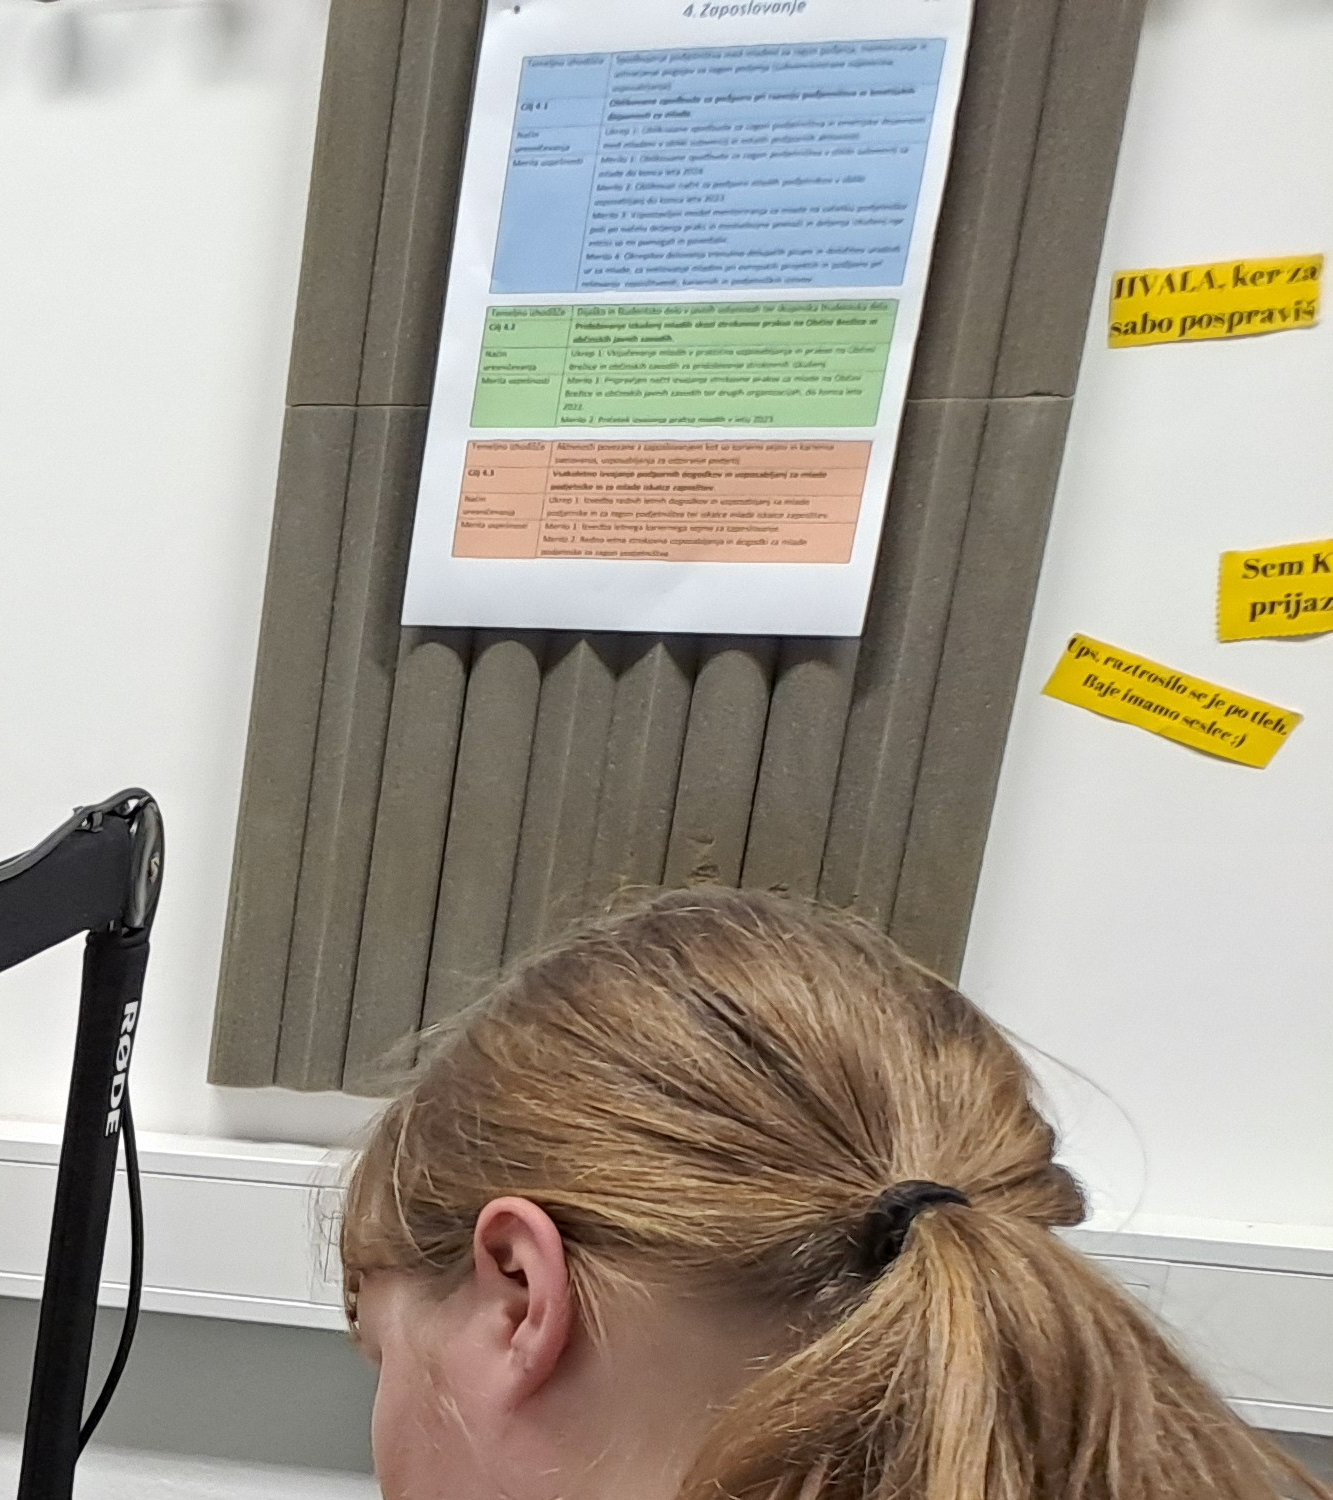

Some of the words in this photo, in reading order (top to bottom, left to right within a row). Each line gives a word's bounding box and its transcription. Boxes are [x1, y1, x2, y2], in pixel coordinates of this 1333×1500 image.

[1233, 263, 1282, 289] ker
[1285, 263, 1318, 283] za
[1109, 312, 1173, 338] sabo
[1179, 299, 1317, 338] pospraviš
[1242, 558, 1304, 580] Sem
[1248, 592, 1333, 622] prijaz
[1082, 673, 1121, 698] Baje
[1120, 688, 1181, 721] imamo
[1223, 704, 1249, 719] po
[104, 1001, 139, 1137] RØDE
